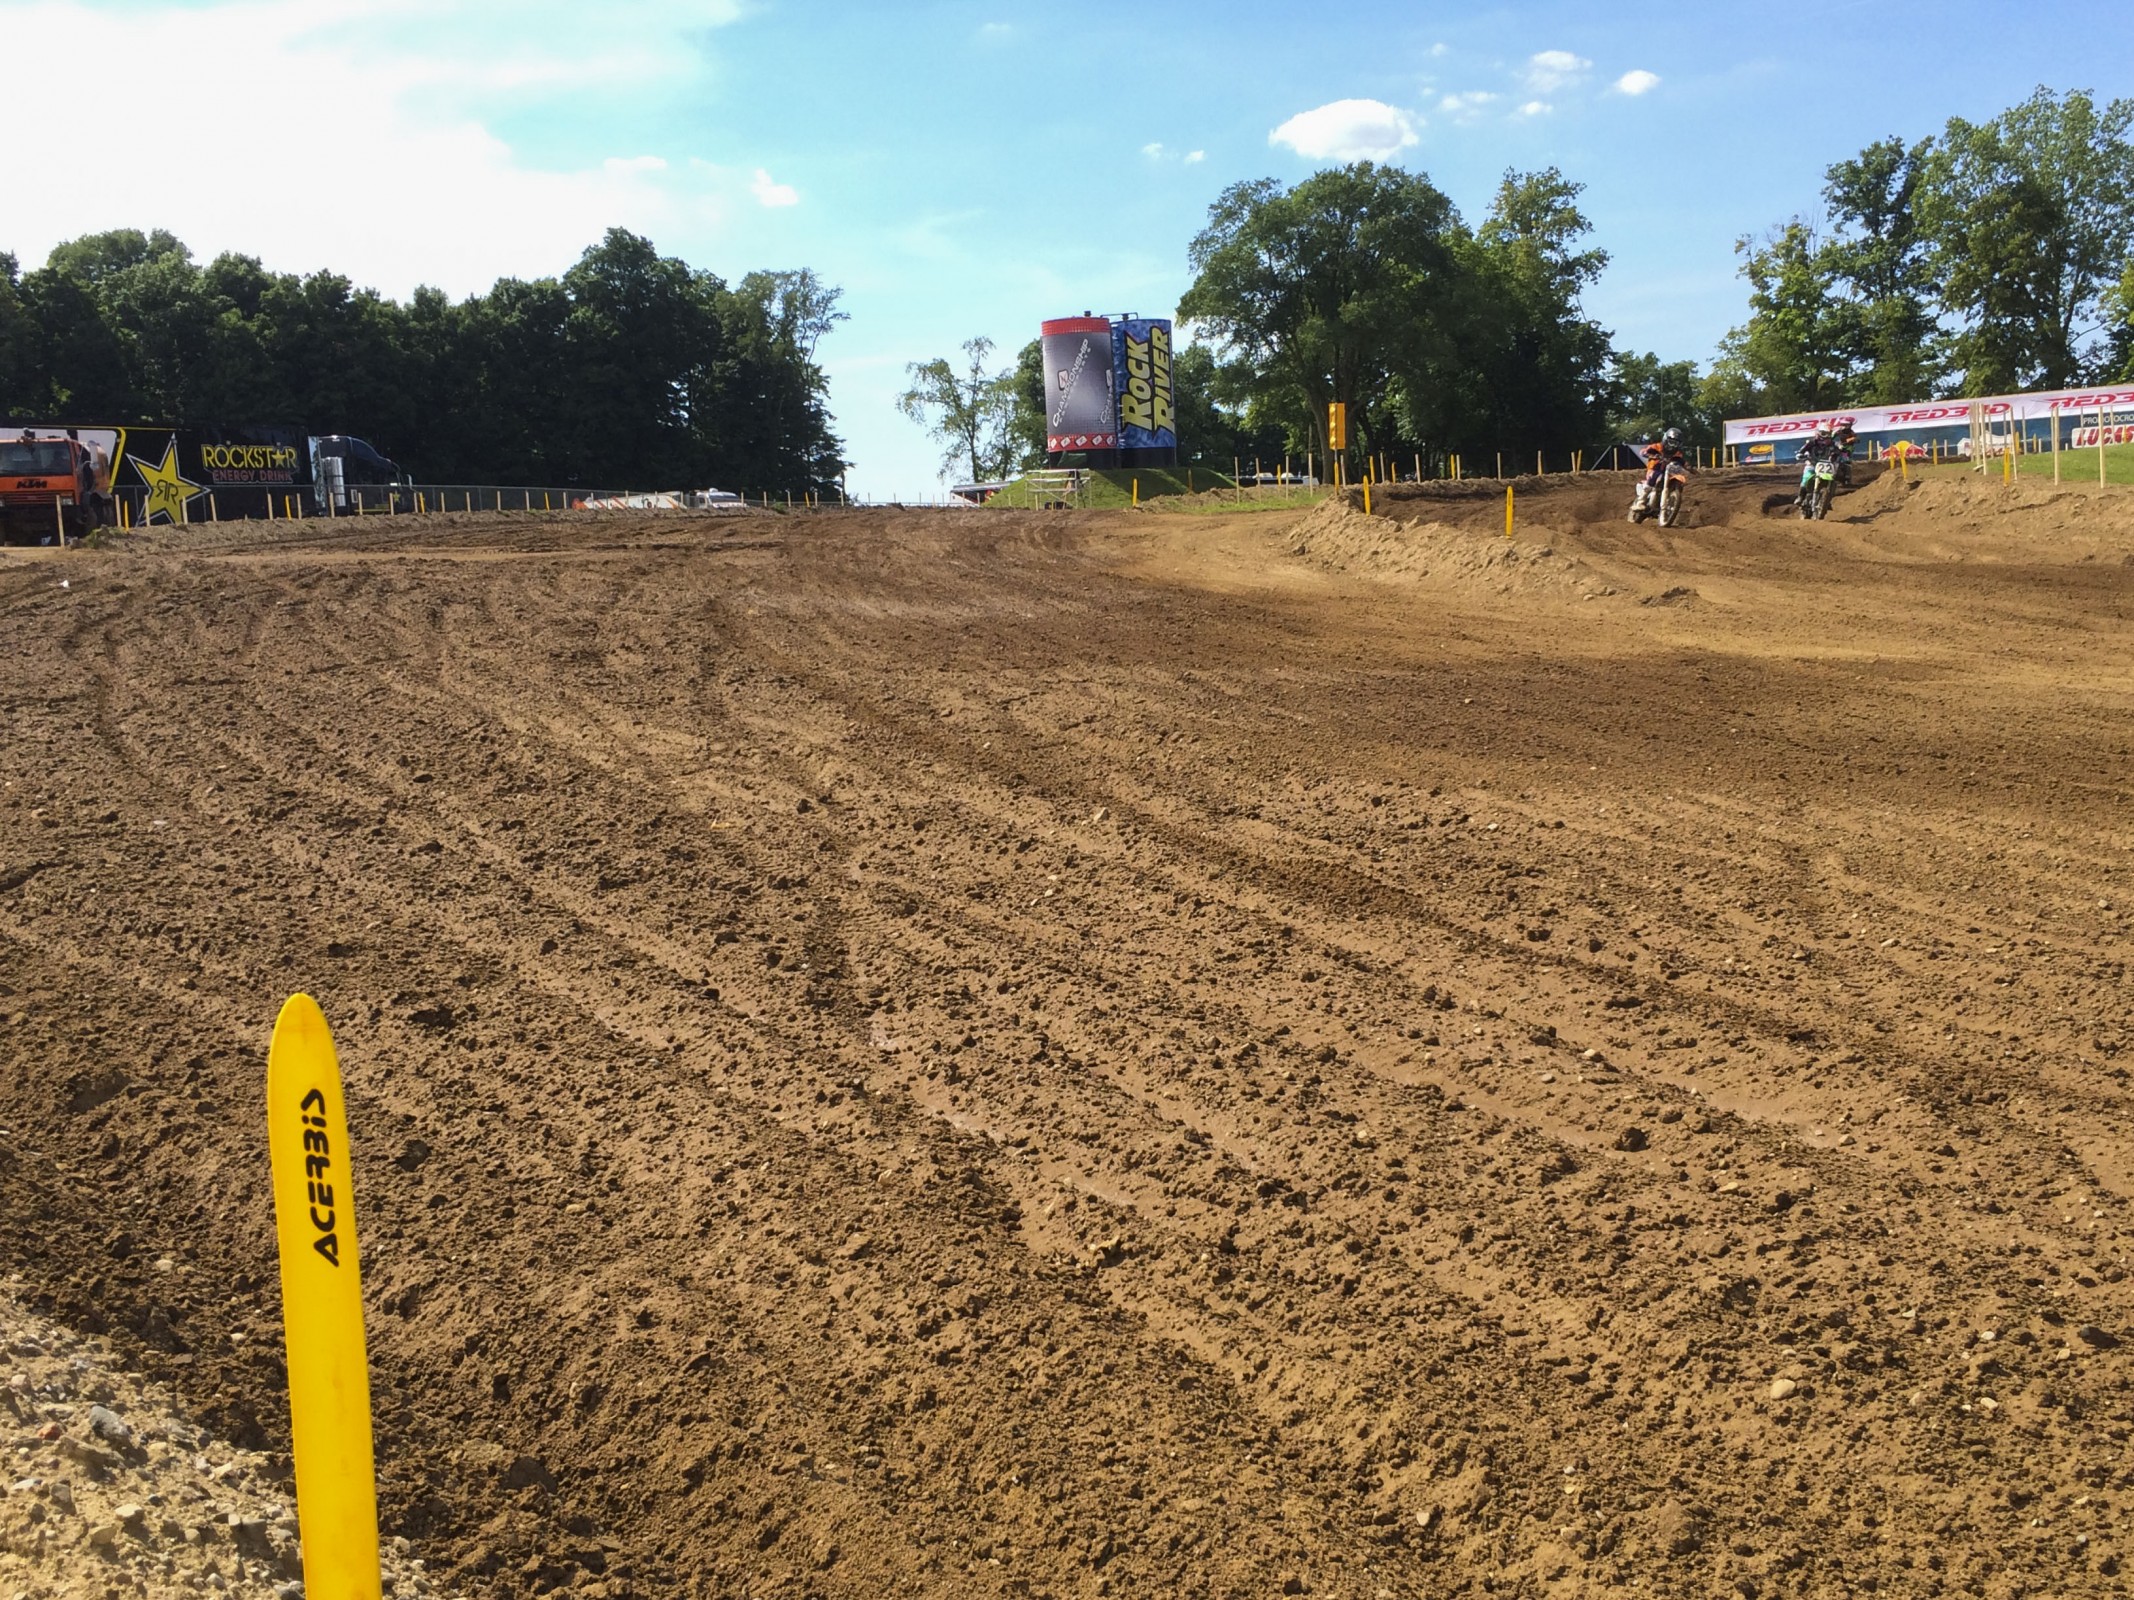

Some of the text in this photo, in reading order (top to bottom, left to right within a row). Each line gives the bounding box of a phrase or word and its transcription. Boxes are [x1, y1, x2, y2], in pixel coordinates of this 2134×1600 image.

[1121, 333, 1153, 431] ROCK
[1153, 326, 1175, 434] RIVER
[1818, 463, 1833, 474] 22
[213, 469, 256, 481] ENERGY
[16, 480, 48, 489] KTM
